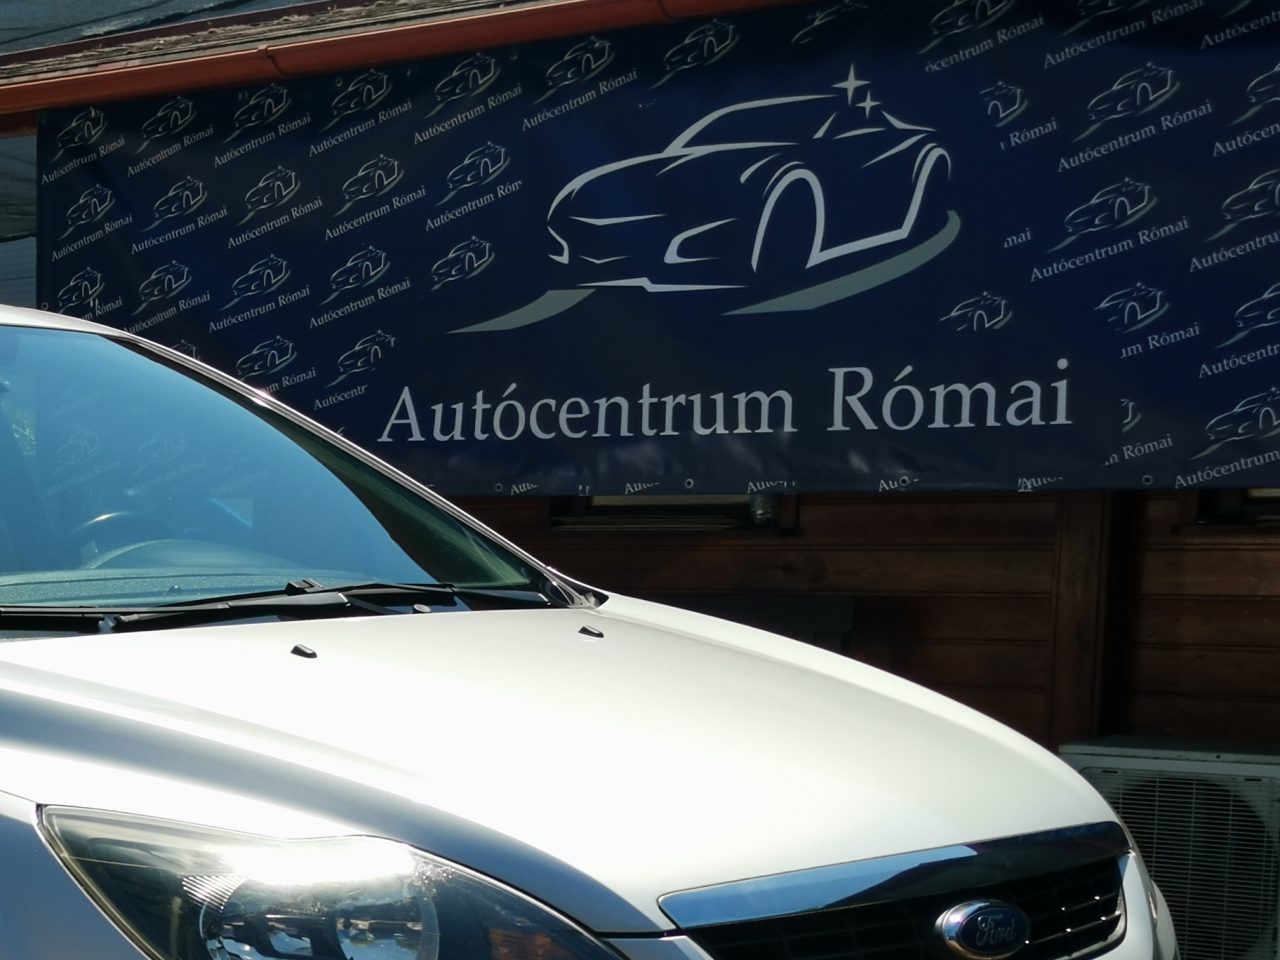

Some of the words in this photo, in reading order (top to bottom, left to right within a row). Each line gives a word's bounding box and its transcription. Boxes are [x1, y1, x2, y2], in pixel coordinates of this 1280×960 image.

[996, 13, 1046, 45] Római
[1043, 17, 1147, 69] Autócentrum
[1150, 0, 1204, 25] Római
[1199, 9, 1280, 50] Autócent
[414, 103, 485, 145] Autócentrum
[487, 83, 523, 110] Római
[521, 90, 597, 132] Autócentrum
[599, 67, 638, 96] Római
[214, 130, 276, 168] Autócentrum
[278, 112, 312, 135] Római
[308, 119, 375, 157] Autócentrum
[378, 98, 412, 124] Római
[1009, 116, 1058, 148] Római
[1057, 124, 1156, 173] Autócentrum
[1159, 99, 1214, 131] Római
[131, 223, 195, 255] Autócentrum
[197, 205, 228, 228] Római
[227, 212, 290, 249] Autócentrum
[291, 196, 323, 220] Római
[324, 203, 390, 241] Autócentrum
[392, 185, 427, 209] Római
[425, 192, 494, 232] Autócentrum
[1030, 238, 1134, 283] Autócentrum
[1137, 215, 1190, 246] Római
[179, 290, 211, 311] Római
[209, 302, 276, 333] Autócentrum
[278, 284, 310, 308] Római
[309, 296, 375, 330] Autócentrum
[377, 277, 411, 301] Római
[1147, 321, 1201, 351] Római
[282, 366, 317, 388] Római
[377, 382, 798, 443] Autócentrum
[826, 357, 1073, 432] Római
[1122, 433, 1174, 460] Római
[976, 914, 1016, 947] Ford
